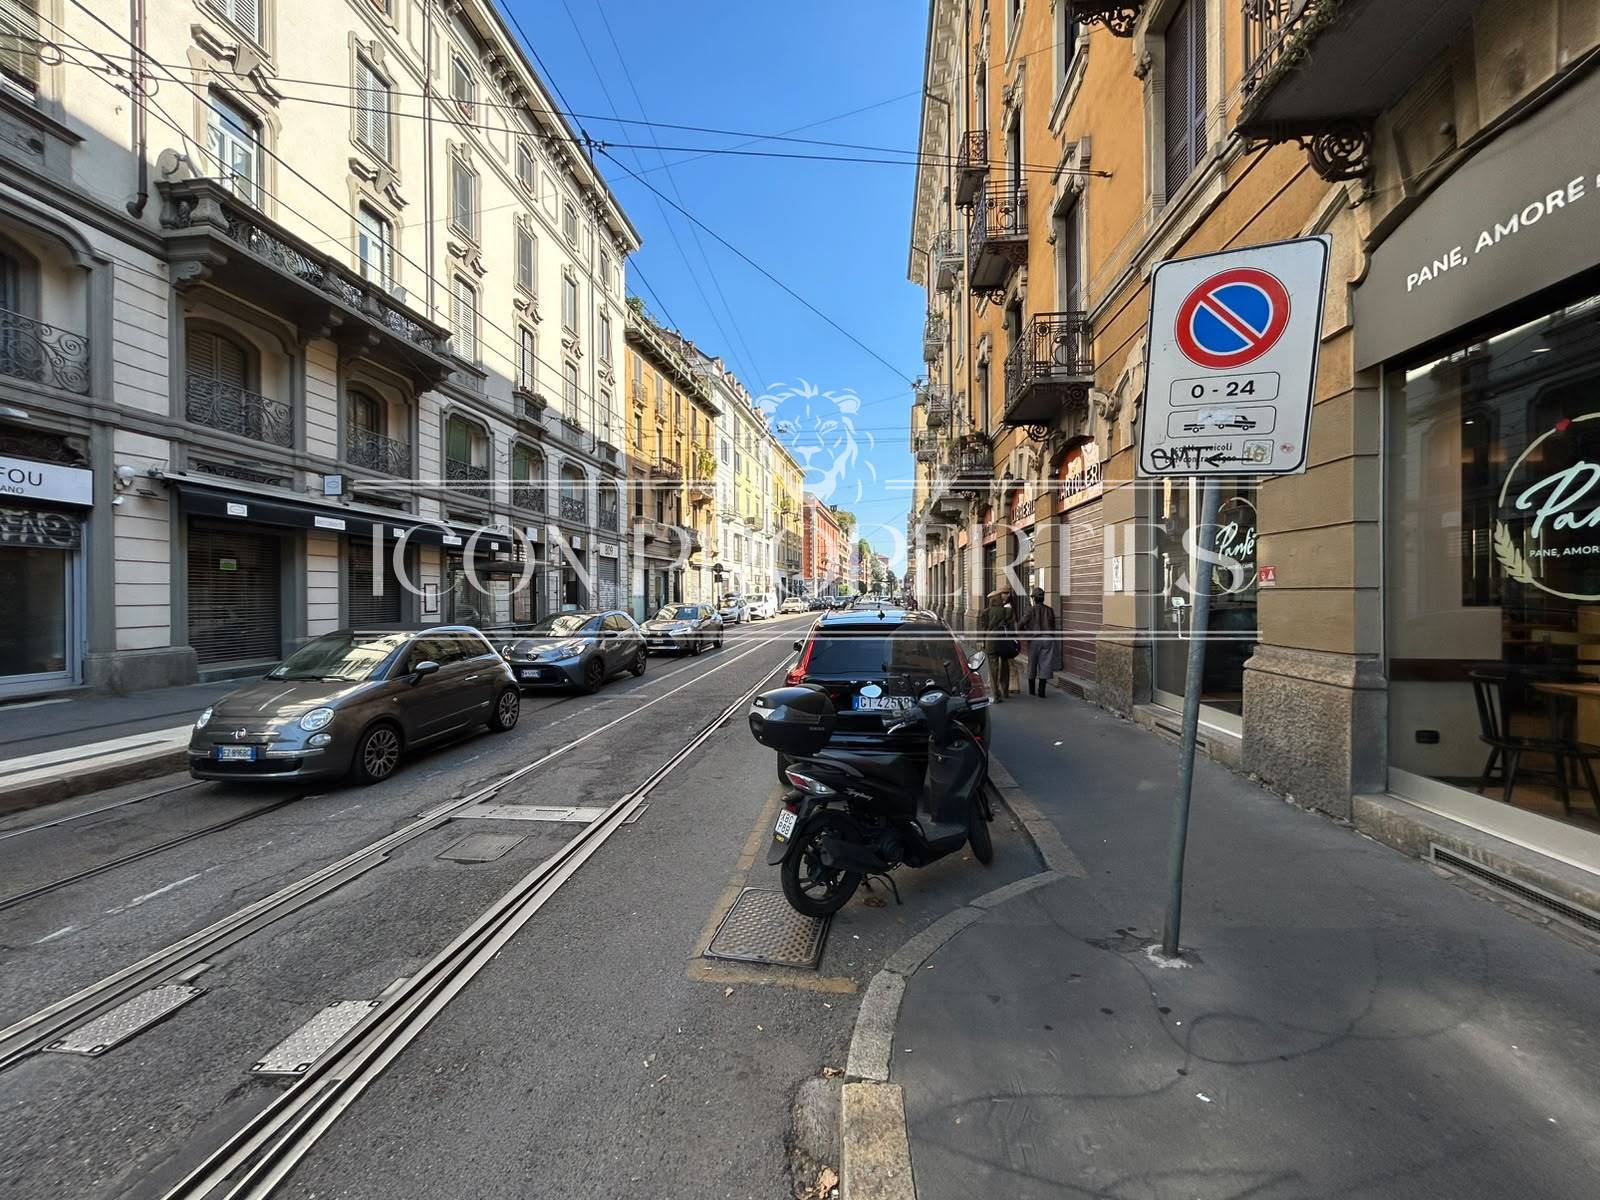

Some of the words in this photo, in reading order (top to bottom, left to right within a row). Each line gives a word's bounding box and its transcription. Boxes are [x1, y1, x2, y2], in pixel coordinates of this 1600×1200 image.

[1407, 246, 1468, 292] PANE,
[1475, 176, 1585, 254] AMORE
[1191, 384, 1204, 399] 0
[1226, 380, 1256, 397] 24
[1529, 548, 1560, 558] PANE,
